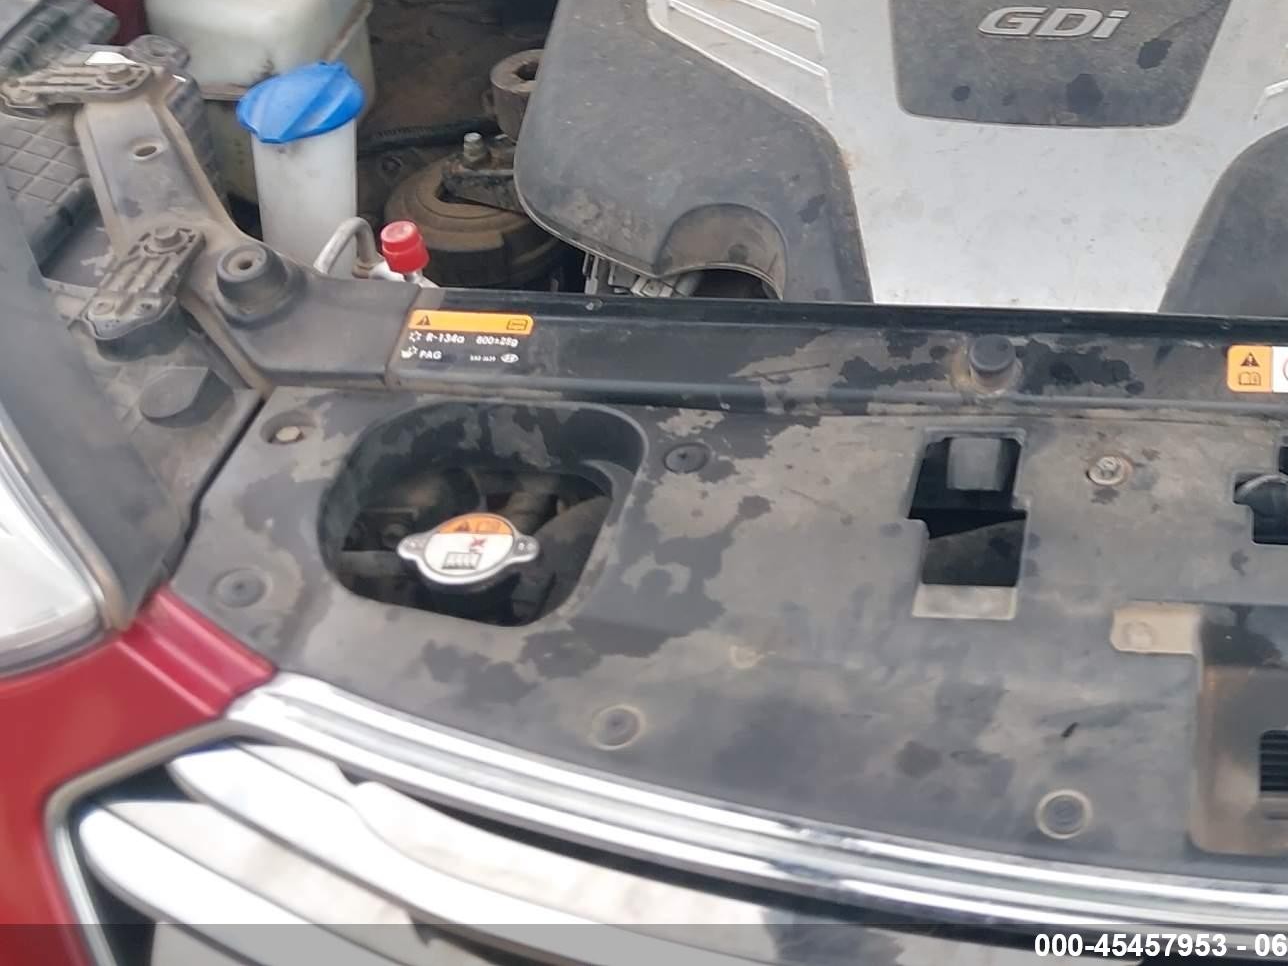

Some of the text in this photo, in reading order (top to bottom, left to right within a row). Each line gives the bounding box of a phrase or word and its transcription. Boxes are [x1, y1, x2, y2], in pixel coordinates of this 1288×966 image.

[978, 6, 1130, 39] GDi
[425, 332, 466, 344] R-134a
[419, 350, 442, 360] PAG
